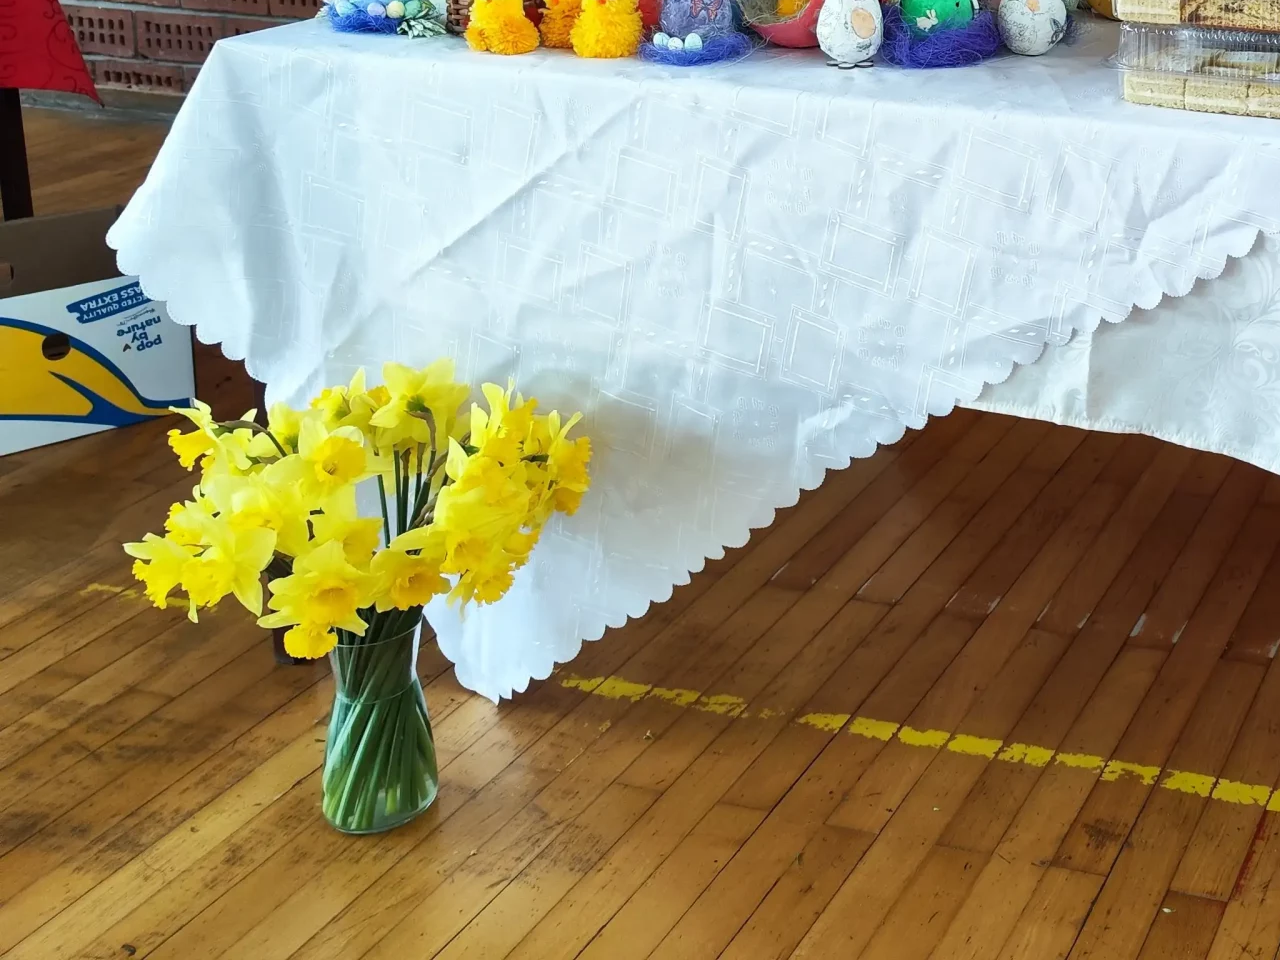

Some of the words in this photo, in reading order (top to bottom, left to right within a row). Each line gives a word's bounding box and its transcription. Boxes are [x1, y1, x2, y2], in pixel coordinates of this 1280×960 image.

[120, 286, 142, 299] ASS
[121, 294, 148, 307] ECTED
[80, 292, 119, 311] EXTRA
[83, 303, 119, 320] QUALITY
[116, 316, 162, 336] nature
[131, 331, 149, 343] by
[136, 334, 163, 351] pop
